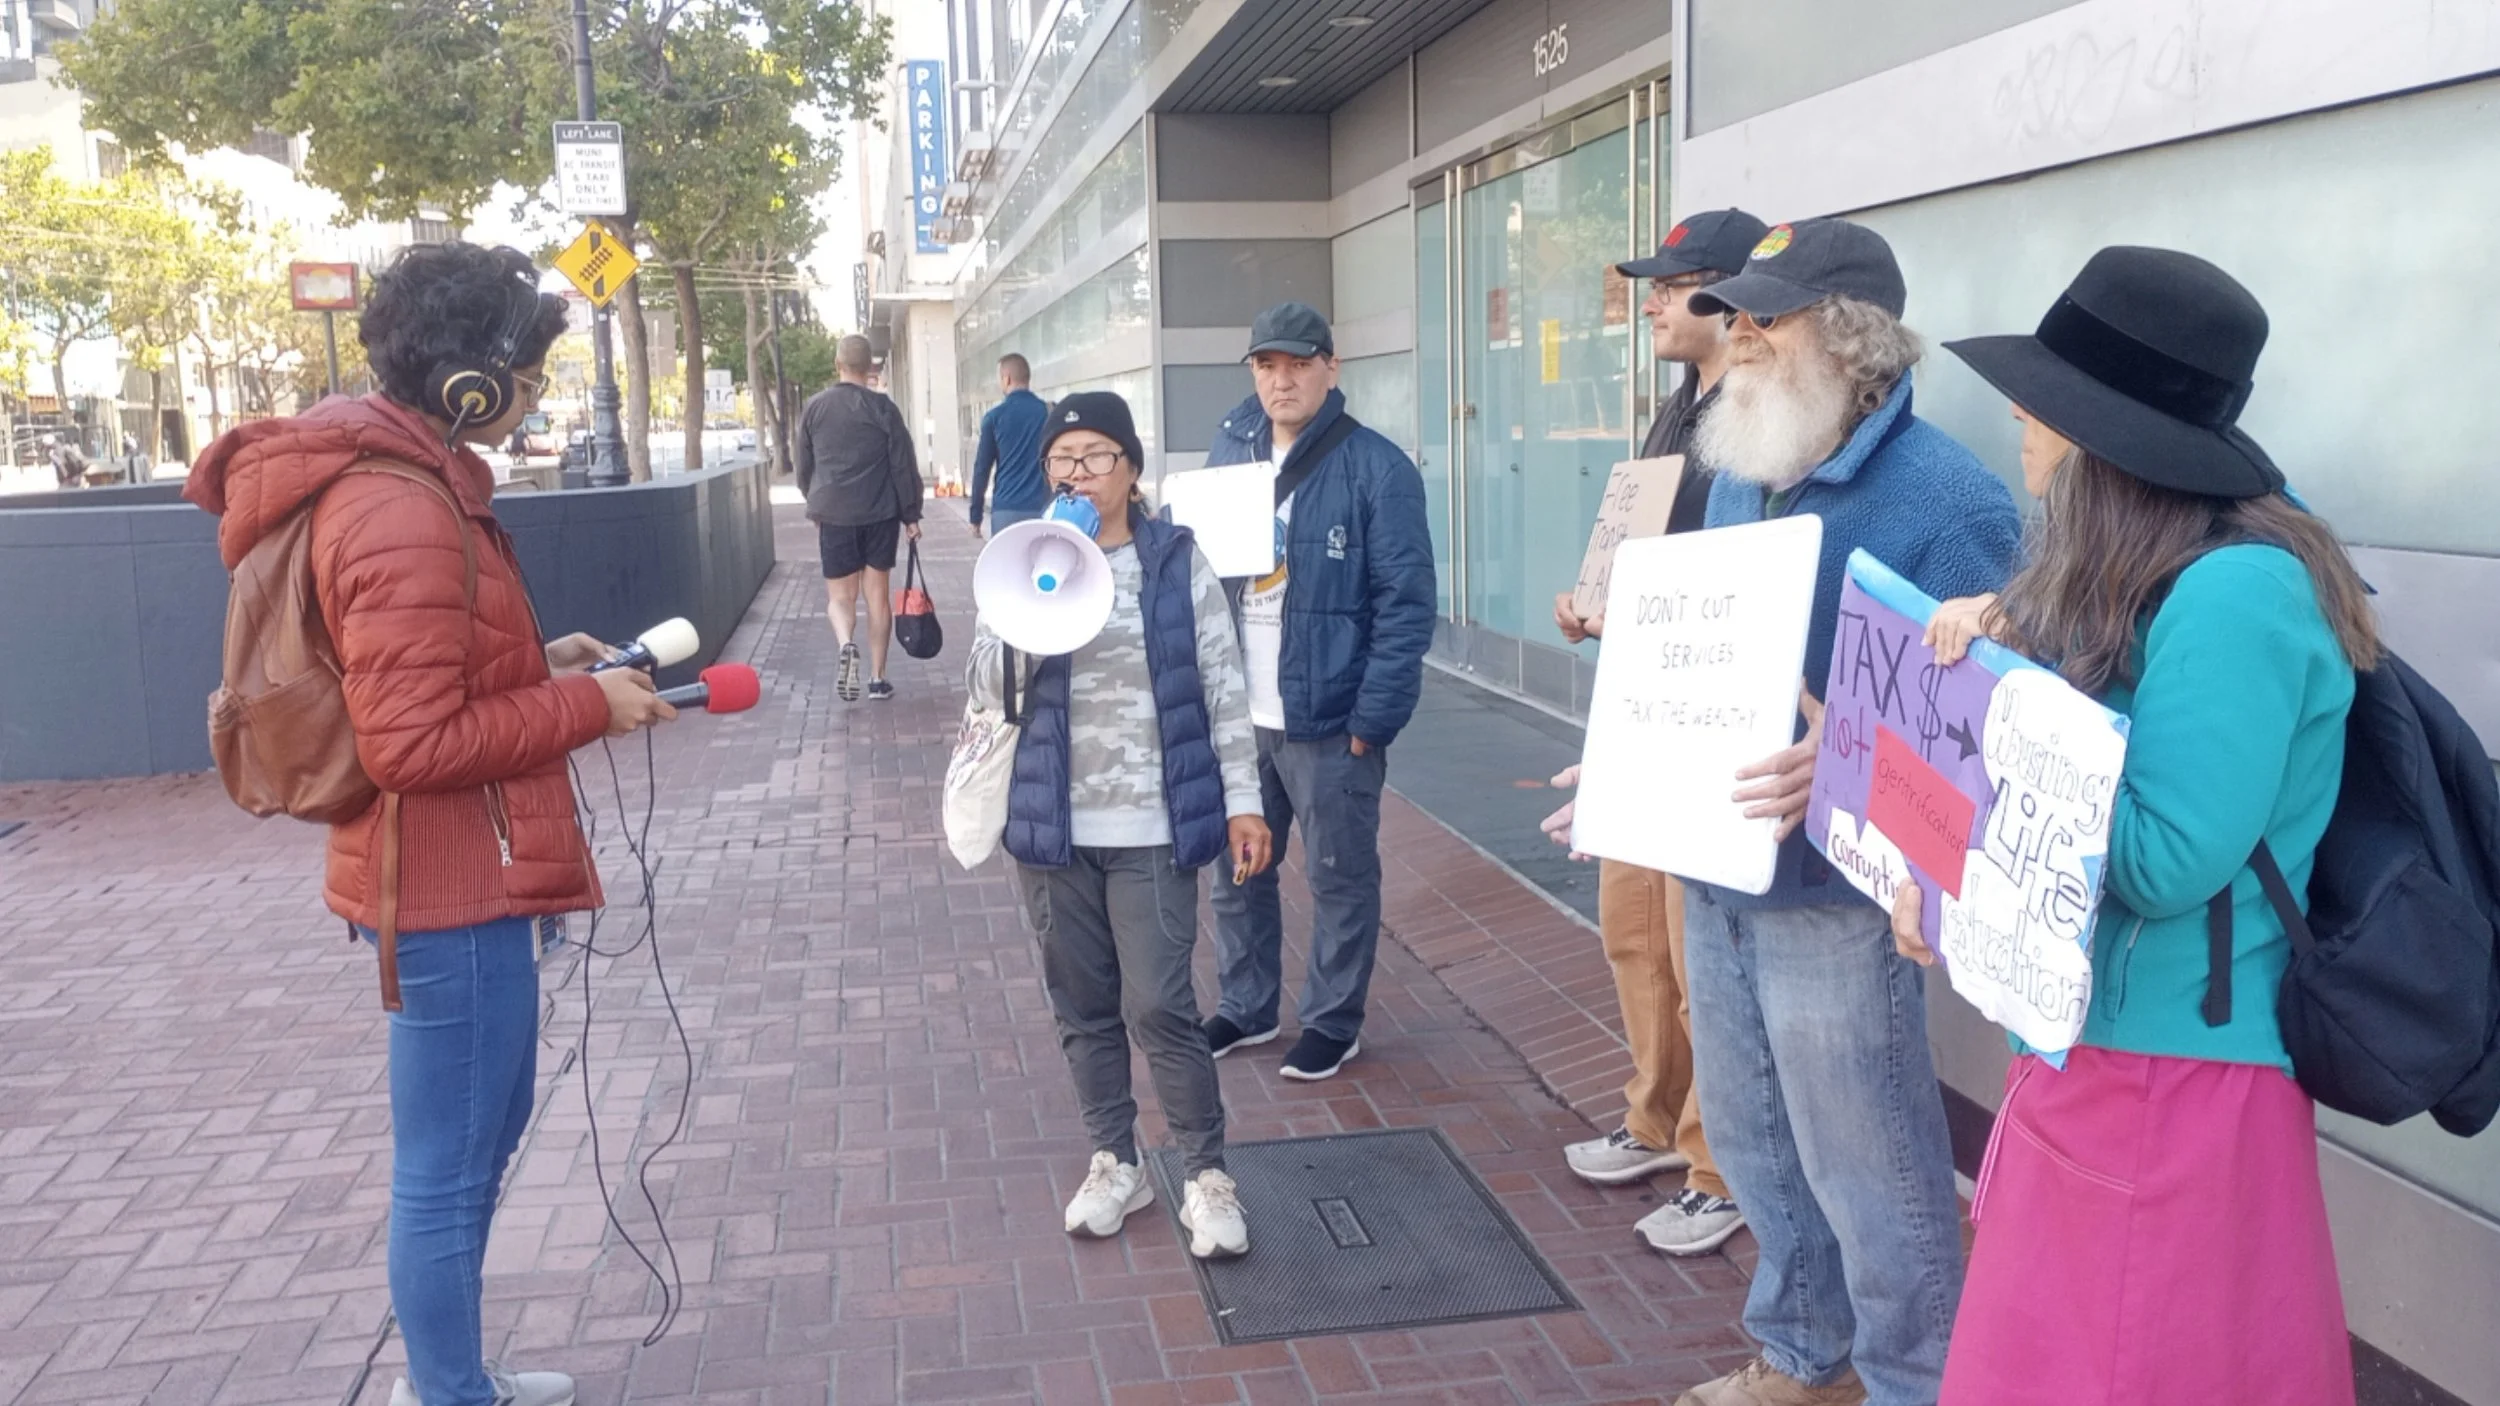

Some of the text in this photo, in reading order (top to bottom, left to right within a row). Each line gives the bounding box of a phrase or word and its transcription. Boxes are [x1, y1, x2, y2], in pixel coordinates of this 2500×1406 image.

[1533, 24, 1568, 77] 1525
[562, 130, 613, 139] LEFT LANE
[575, 148, 603, 156] MUNI
[915, 67, 938, 214] PARKING
[575, 184, 607, 194] ONLY
[580, 160, 616, 169] TRANSIT
[1636, 588, 1736, 626] DON'T CUT
[1661, 641, 1734, 669] SERVICES
[1840, 609, 1953, 764] TAX $
[1623, 697, 1756, 731] TAX THE WEALTHY
[1823, 701, 1871, 775] not
[1986, 682, 2111, 836] Housing
[1877, 757, 1967, 862] gentrification
[1832, 833, 1899, 900] corrupti
[1983, 776, 2089, 941] Life
